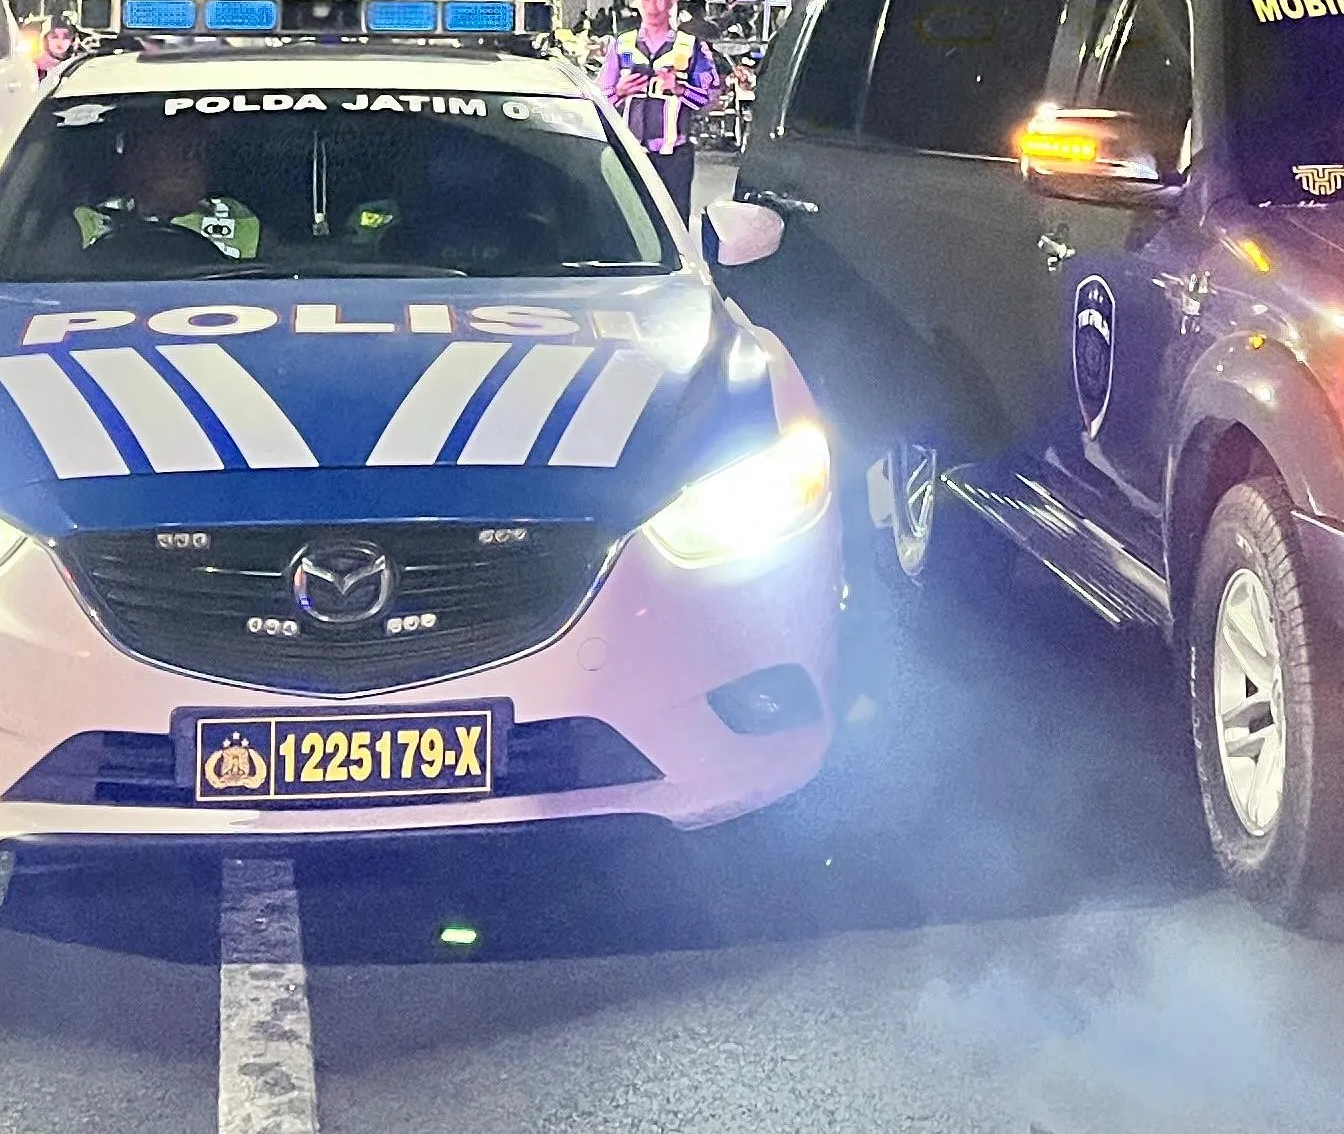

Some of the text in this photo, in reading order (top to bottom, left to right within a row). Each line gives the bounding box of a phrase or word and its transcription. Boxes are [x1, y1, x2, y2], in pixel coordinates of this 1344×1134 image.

[164, 94, 487, 116] POLDA JATIM
[21, 301, 641, 347] POLISI
[279, 726, 482, 783] 1225179-X
